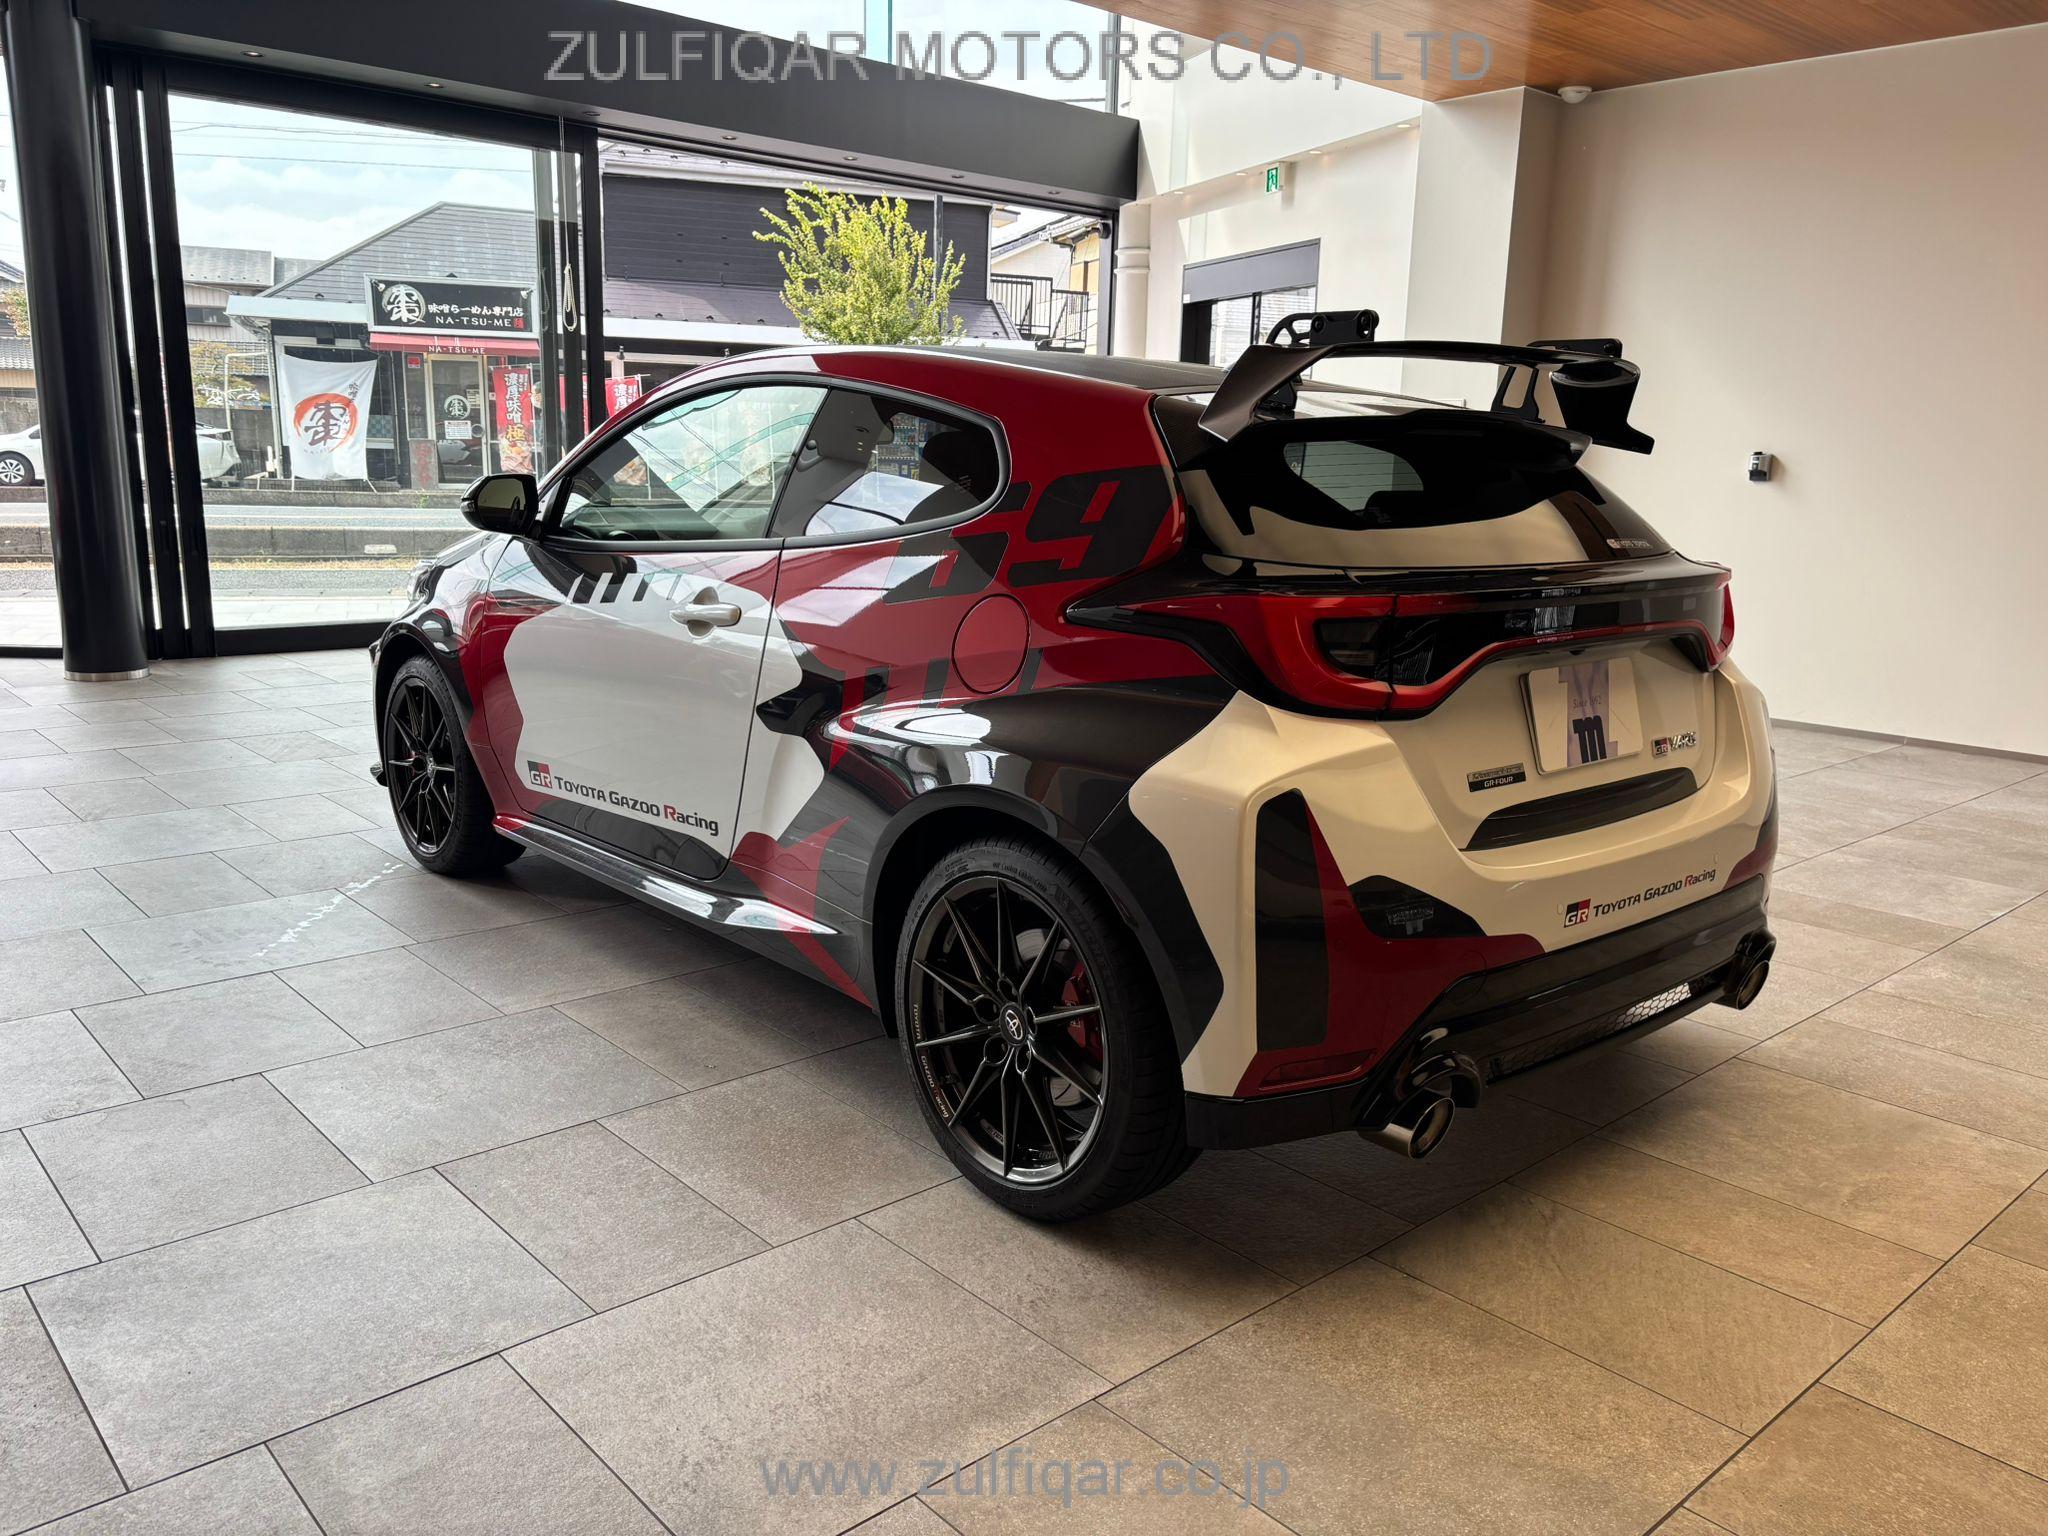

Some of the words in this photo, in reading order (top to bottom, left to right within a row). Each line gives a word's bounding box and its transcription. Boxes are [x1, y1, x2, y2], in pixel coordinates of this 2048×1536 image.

[427, 302, 525, 317] 味噌らーめん専門店
[435, 316, 512, 327] NA-TSU-ME
[428, 346, 486, 355] NA-TSU-ME
[529, 769, 553, 789] GR
[553, 775, 606, 802] TOYOTA
[608, 791, 660, 817] GAZOO
[663, 804, 719, 836] Racing
[1564, 906, 1590, 928] GR
[1593, 895, 1641, 918] TOYOTA
[1643, 880, 1683, 902] GAZOO
[1683, 868, 1717, 889] Racing
